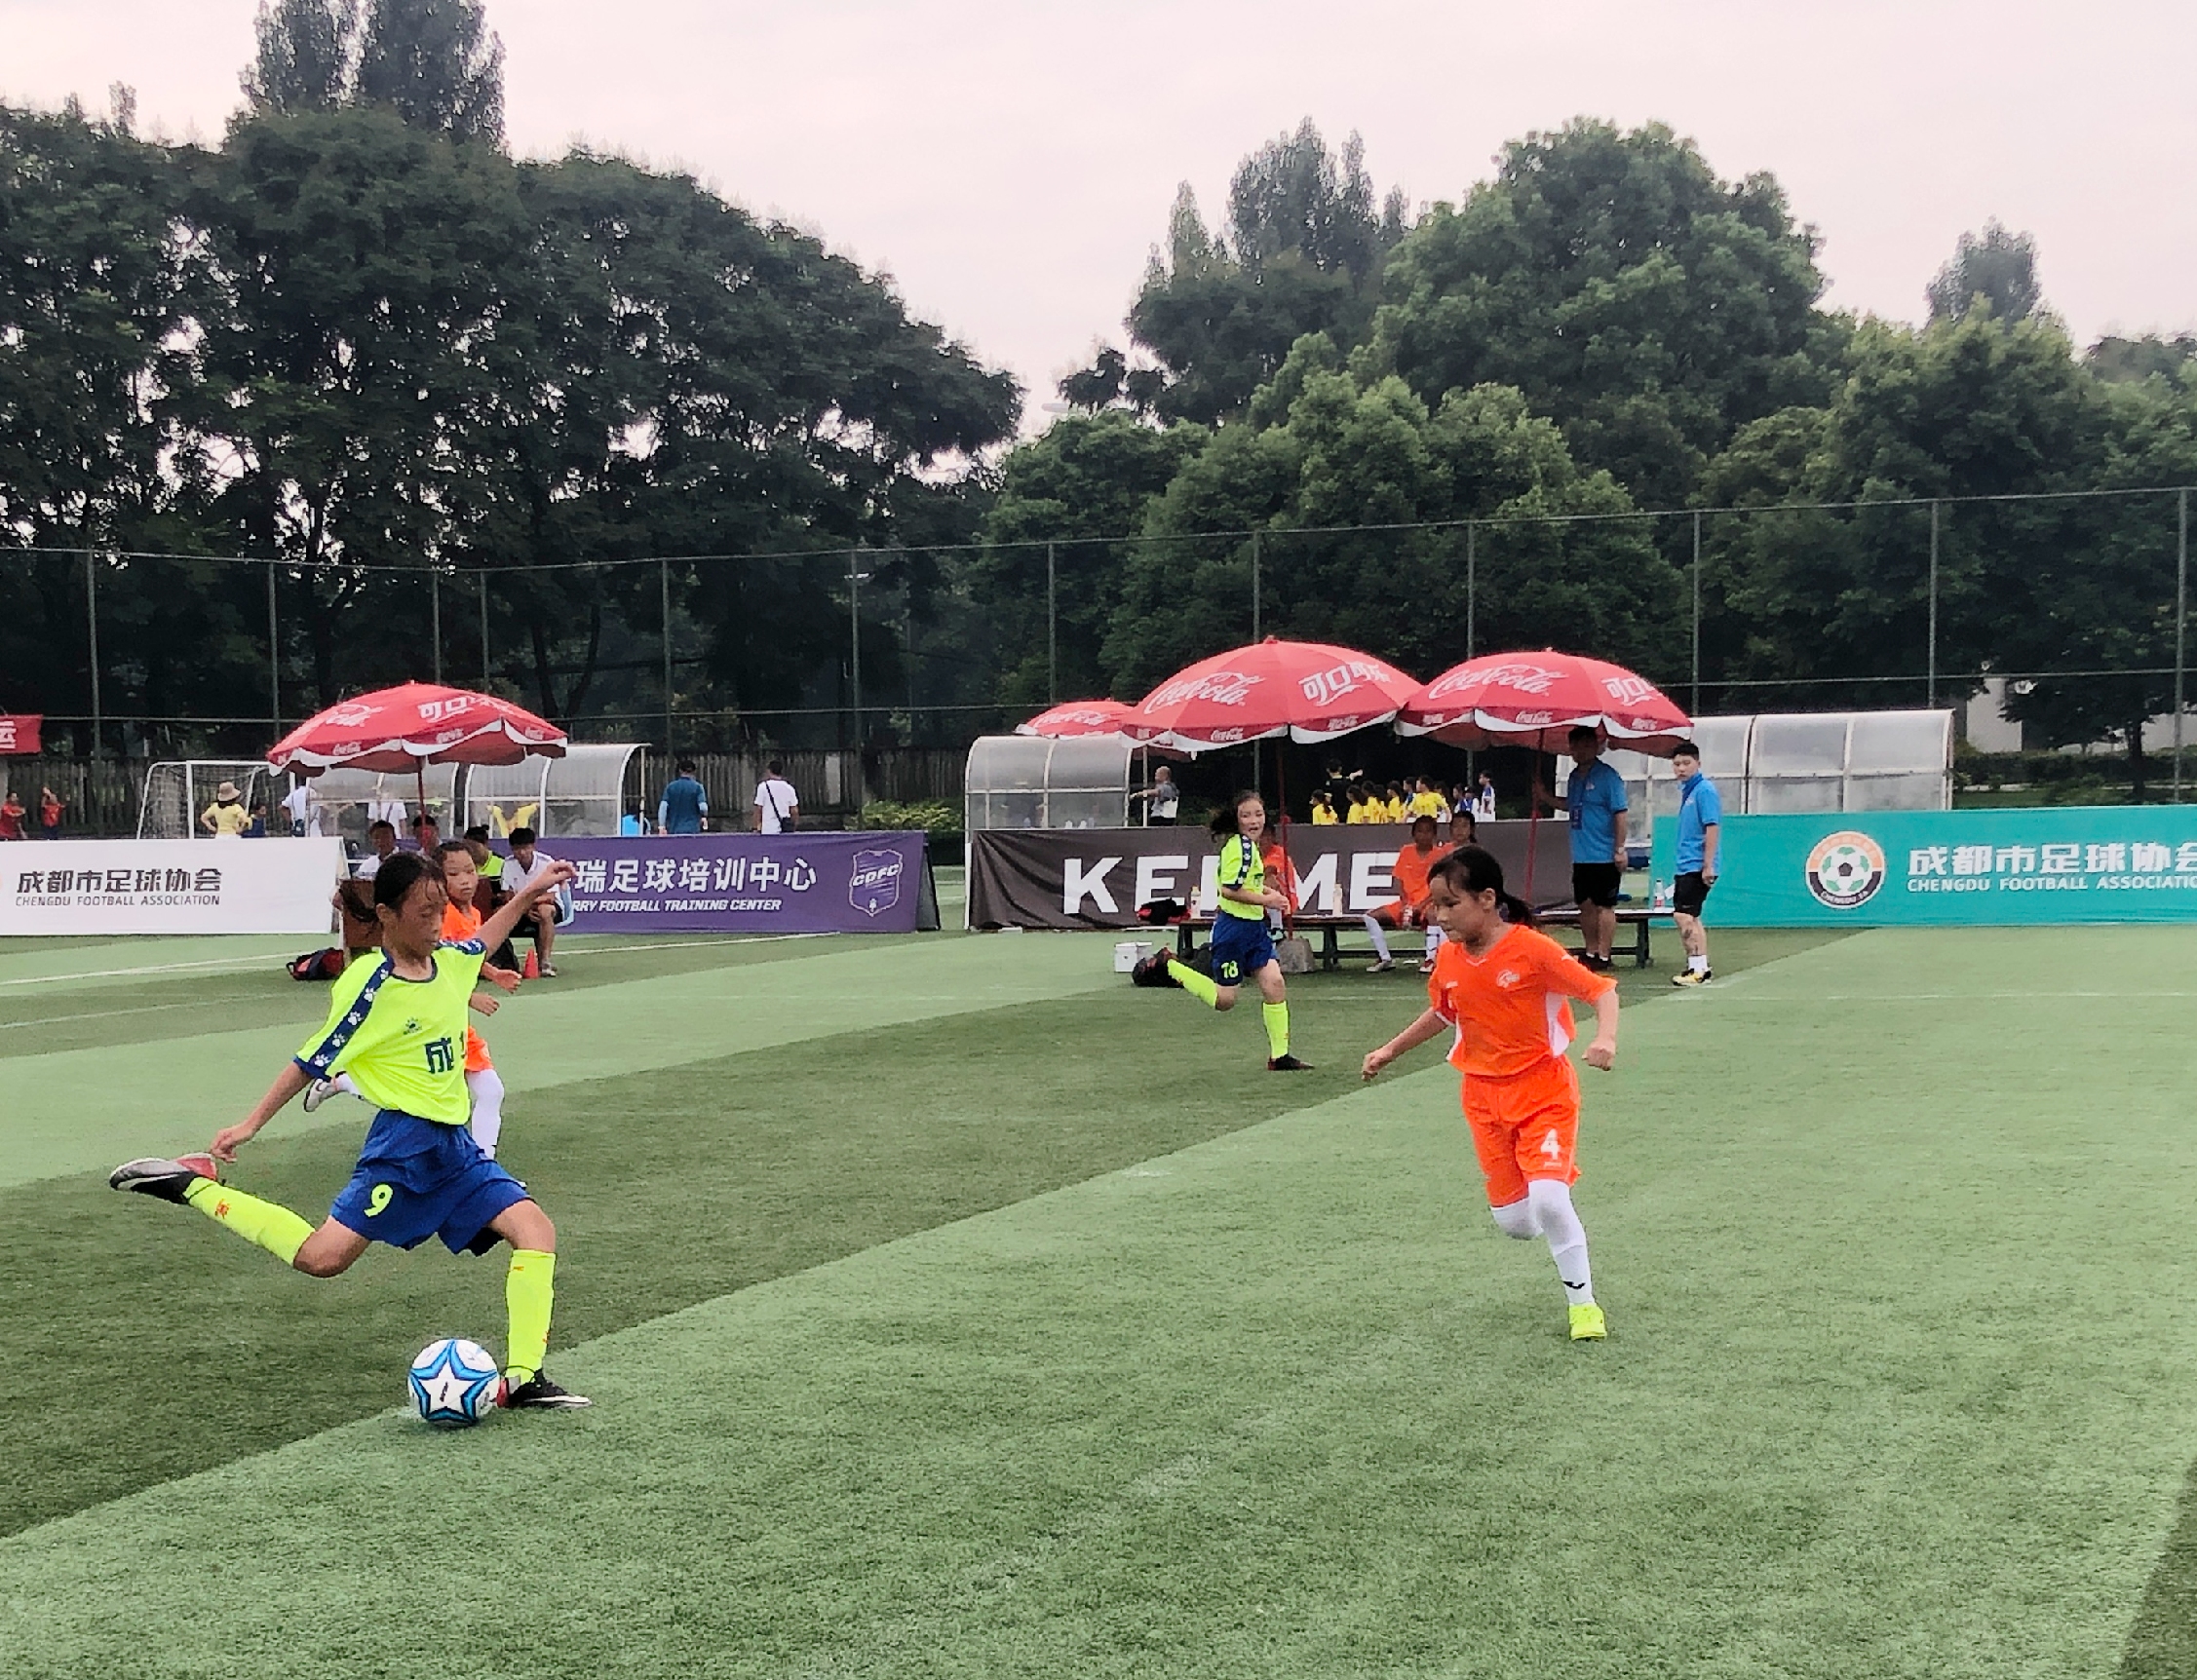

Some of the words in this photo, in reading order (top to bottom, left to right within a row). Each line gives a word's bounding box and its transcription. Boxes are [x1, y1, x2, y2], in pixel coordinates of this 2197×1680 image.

[17, 868, 222, 894] 成都市足球协会
[569, 857, 817, 894] 瑞足球培训中心
[1908, 878, 1989, 892] CHENGDU
[1999, 877, 2088, 891] FOOTBALL
[16, 896, 71, 906] CHENGDU
[77, 896, 135, 906] FOOTBALL
[140, 895, 220, 906] ASSOCIATION
[572, 899, 598, 912] RRY
[598, 899, 661, 912] FOOTBALL
[665, 899, 729, 912] TRAINING
[730, 898, 783, 912] CENTER
[1221, 960, 1239, 979] 18
[1540, 1128, 1561, 1160] 4
[364, 1183, 394, 1218] 9
